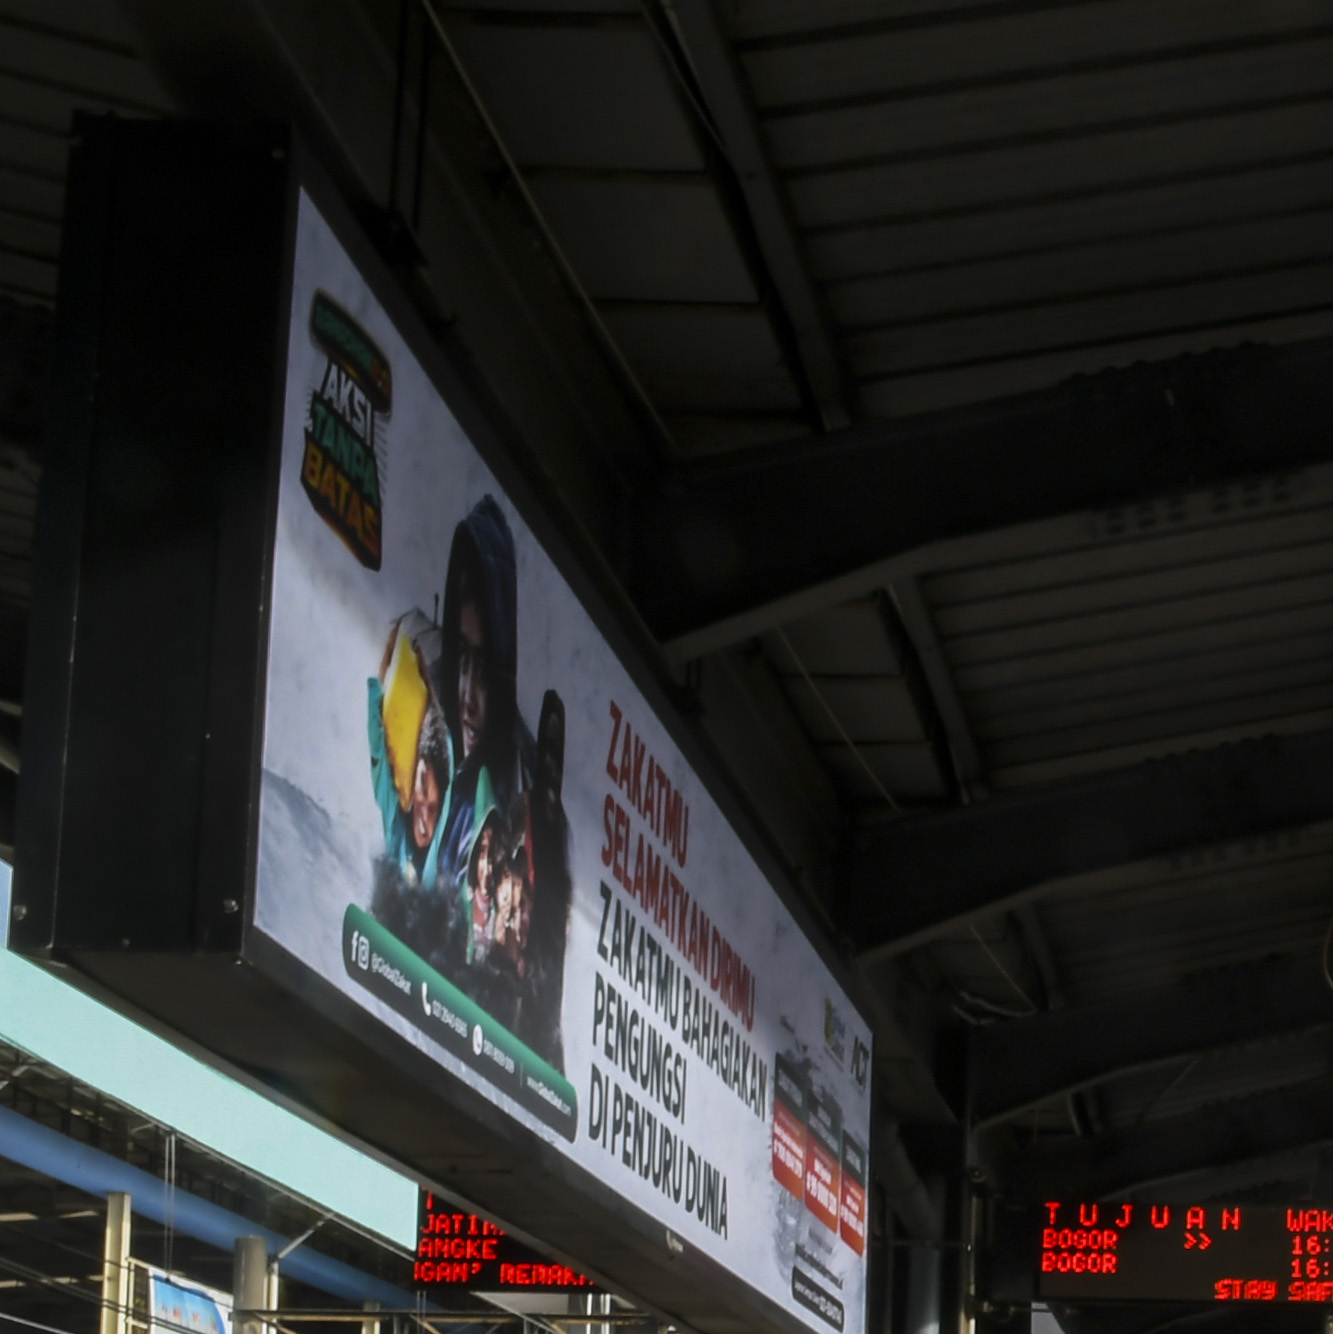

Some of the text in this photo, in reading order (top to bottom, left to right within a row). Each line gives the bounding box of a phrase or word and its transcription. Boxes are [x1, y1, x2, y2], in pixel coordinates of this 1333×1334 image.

[313, 402, 380, 505] TANPA
[321, 360, 374, 447] AKSI
[304, 441, 381, 557] BATAS
[606, 700, 689, 867] ZAKATMU
[602, 793, 755, 1032] SELAMATKAN DIRIMU
[592, 971, 687, 1124] PENGUNGSI
[597, 880, 767, 1122] ZAKATMU BAHAGIAKAN
[588, 1062, 610, 1149] DI
[611, 1082, 684, 1204] PENJURU
[685, 1145, 728, 1240] DUNIA
[418, 1237, 499, 1260] ANGKE
[1042, 1228, 1118, 1250] BOGOR
[1042, 1251, 1117, 1274] BOGOR
[1214, 1279, 1278, 1300] STAY
